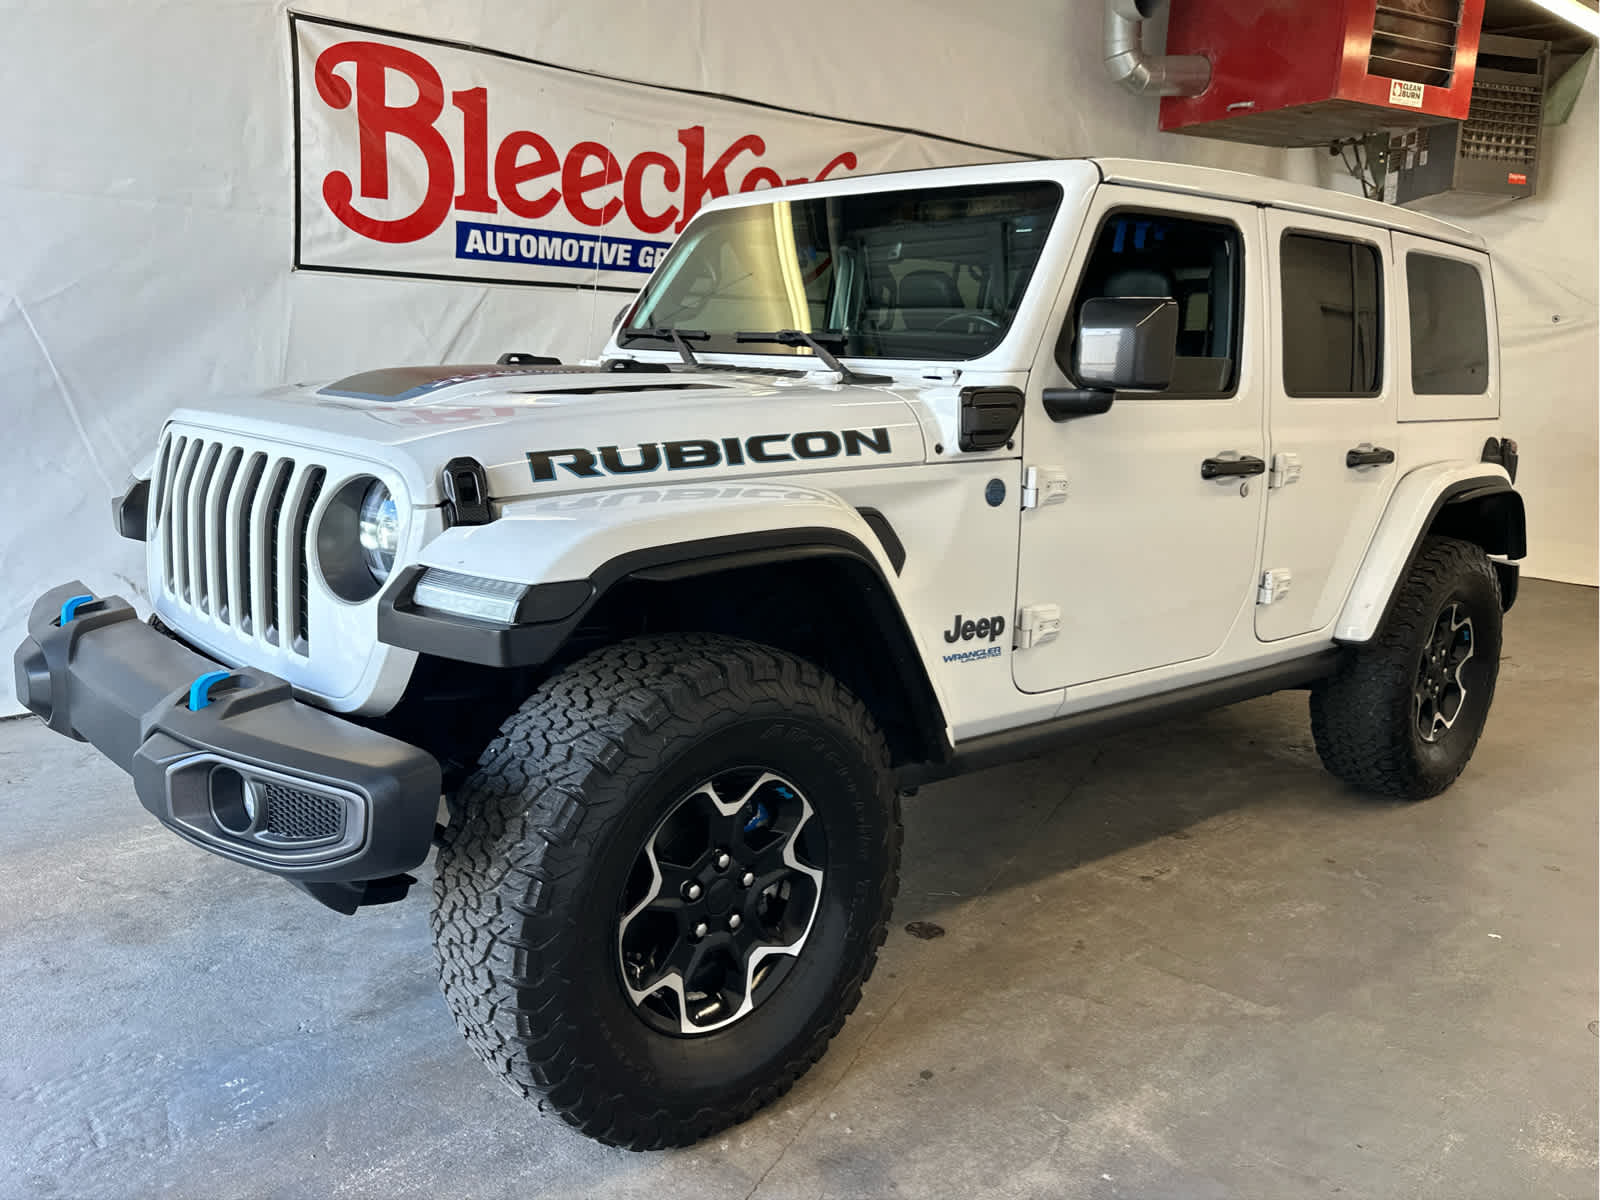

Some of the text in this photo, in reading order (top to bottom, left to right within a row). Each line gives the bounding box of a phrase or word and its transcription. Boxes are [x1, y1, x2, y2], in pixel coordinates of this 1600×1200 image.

[1401, 90, 1421, 100] BURN
[1402, 83, 1422, 92] CLEAN
[465, 229, 632, 266] AUTOMOTIVE
[526, 427, 892, 483] RUBICON
[944, 614, 1005, 643] Jeep
[943, 646, 1001, 663] WRANGLER
